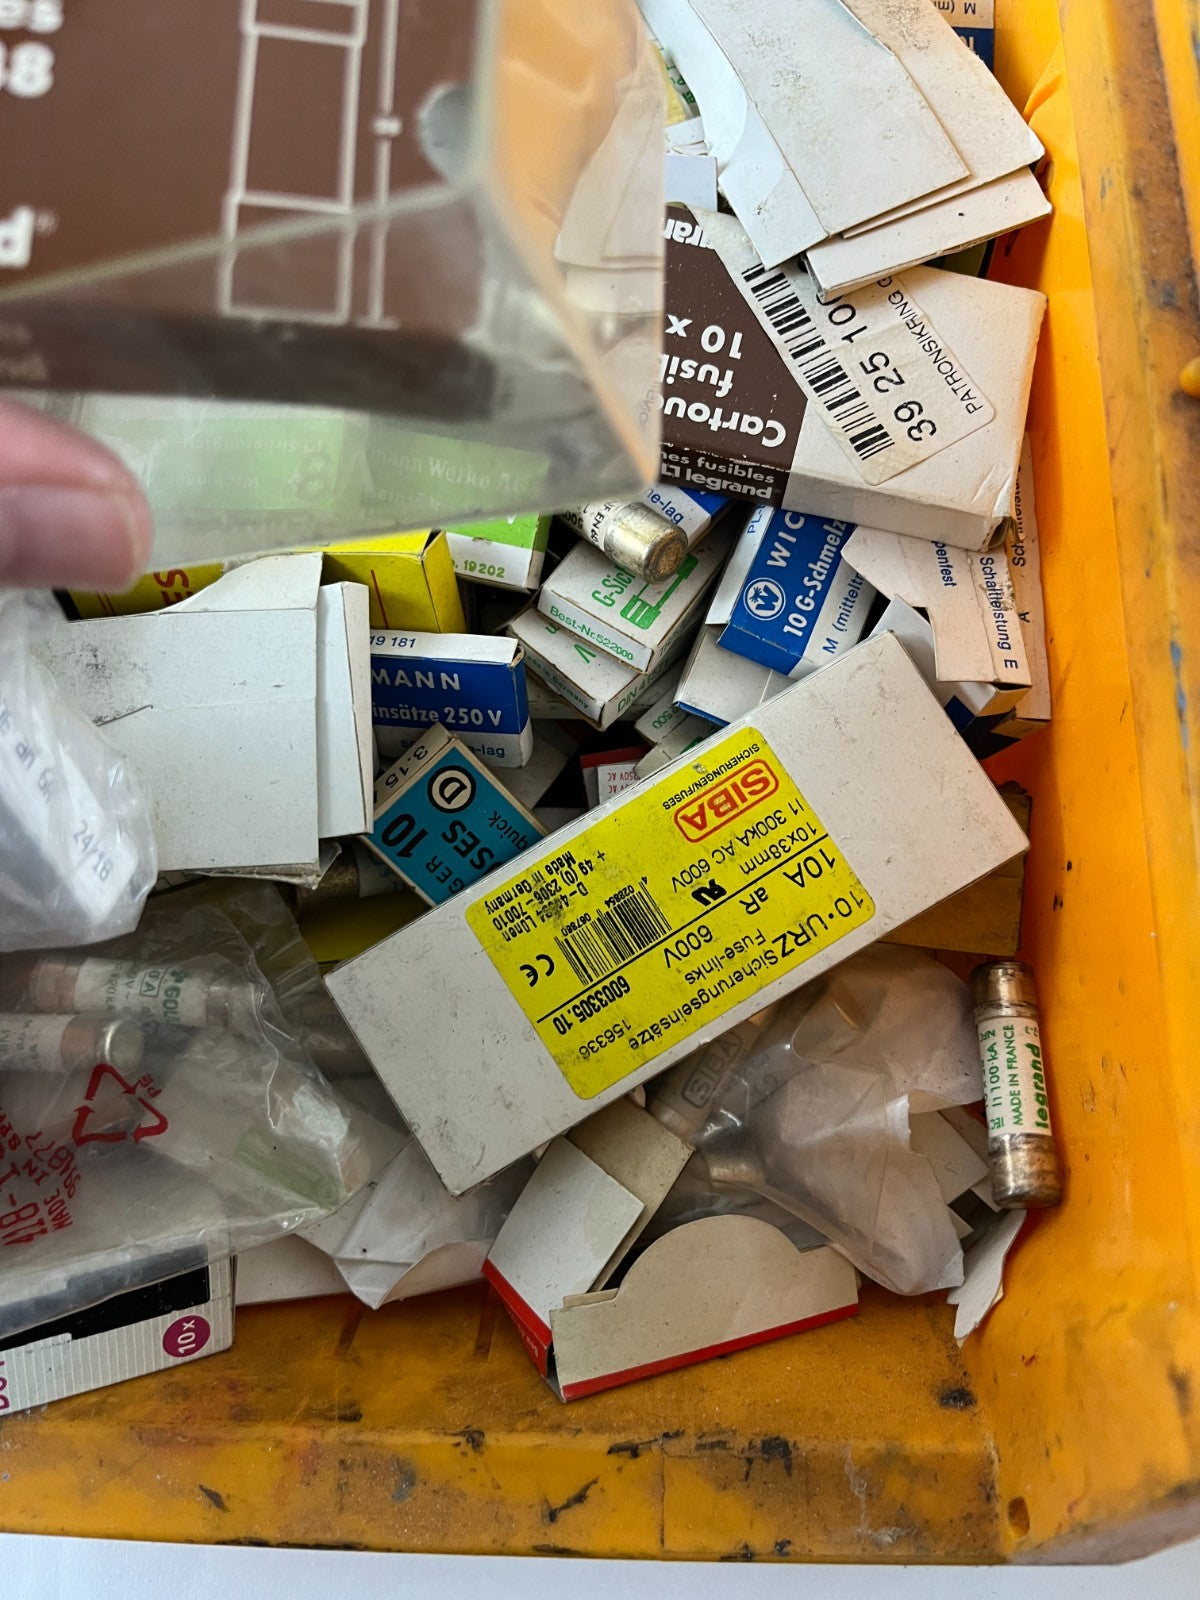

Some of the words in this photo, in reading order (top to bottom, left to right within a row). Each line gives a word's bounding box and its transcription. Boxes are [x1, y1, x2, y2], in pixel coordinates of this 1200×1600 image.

[665, 314, 693, 337] x
[701, 325, 742, 359] 10
[859, 351, 905, 394] 25
[888, 294, 983, 414] PATRONSIKRING
[657, 395, 787, 448] Cartou
[893, 400, 938, 441] 39
[686, 468, 773, 500] legrand
[697, 457, 775, 484] fusibles
[783, 612, 808, 637] 10
[979, 556, 1012, 651] Schaltleistung
[1004, 658, 1018, 669] E
[391, 636, 416, 648] 181
[822, 637, 839, 653] M
[371, 668, 461, 691] MANN
[443, 706, 484, 726] 250
[487, 709, 502, 727] V
[616, 688, 637, 713] DIN
[439, 776, 468, 805] D
[662, 743, 760, 811] SICHERUNGEN/FUSES
[680, 767, 771, 832] SIBA
[381, 813, 429, 859] 10
[488, 810, 529, 851] quick
[737, 809, 787, 847] 300kA
[545, 851, 576, 875] Made
[711, 840, 736, 865] AC
[739, 822, 817, 875] 10x38mm
[580, 859, 594, 876] 49
[671, 859, 711, 893] 600V
[783, 848, 836, 888] 10A
[484, 879, 533, 915] Germany
[739, 886, 769, 915] aR
[663, 924, 713, 970] 600V
[684, 928, 767, 985] Fuse-links
[552, 975, 631, 1036] 6003305.10
[628, 949, 780, 1051] Sicherungseinsätze
[578, 1018, 632, 1060] 156336
[1002, 1024, 1018, 1070] FRANCE
[1007, 1073, 1019, 1086] IN
[1024, 1042, 1050, 1129] legrand
[1008, 1089, 1024, 1125] MADE
